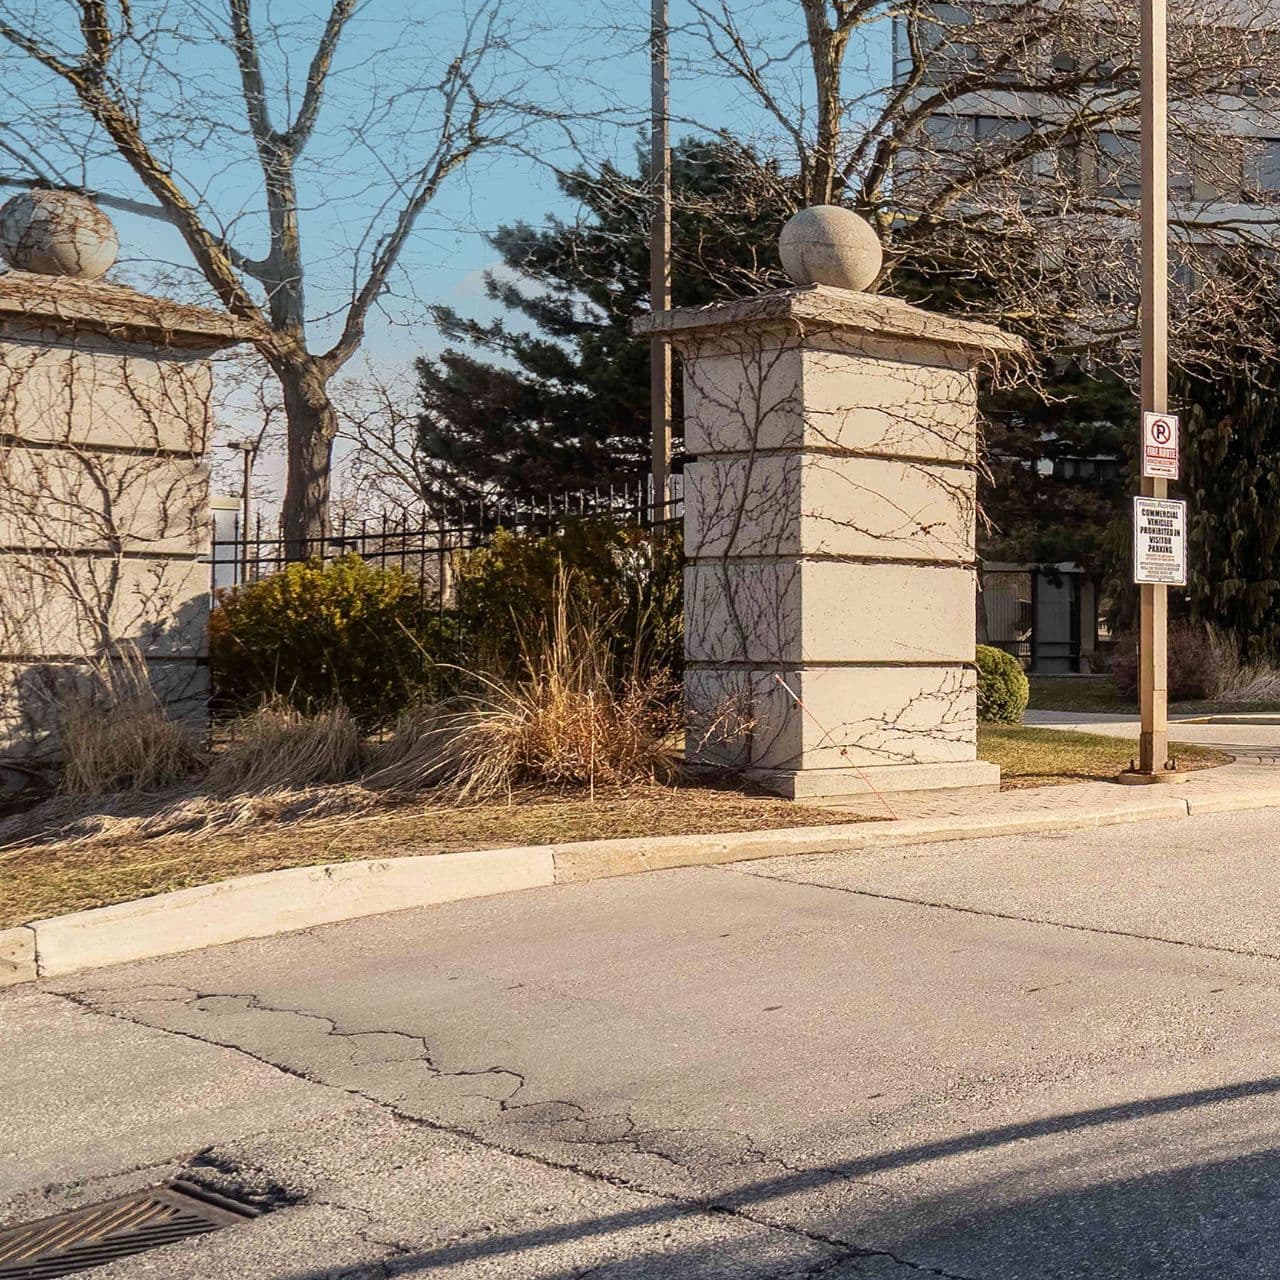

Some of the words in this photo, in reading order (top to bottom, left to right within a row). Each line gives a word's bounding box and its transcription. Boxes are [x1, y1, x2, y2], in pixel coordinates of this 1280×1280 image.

[1141, 508, 1179, 519] COMMERCIAL
[1147, 518, 1173, 527] VEHICLES
[1140, 526, 1173, 536] PROHIBITED
[1174, 528, 1180, 536] IN
[1149, 535, 1172, 545] VISITOR
[1147, 544, 1173, 554] PARKING
